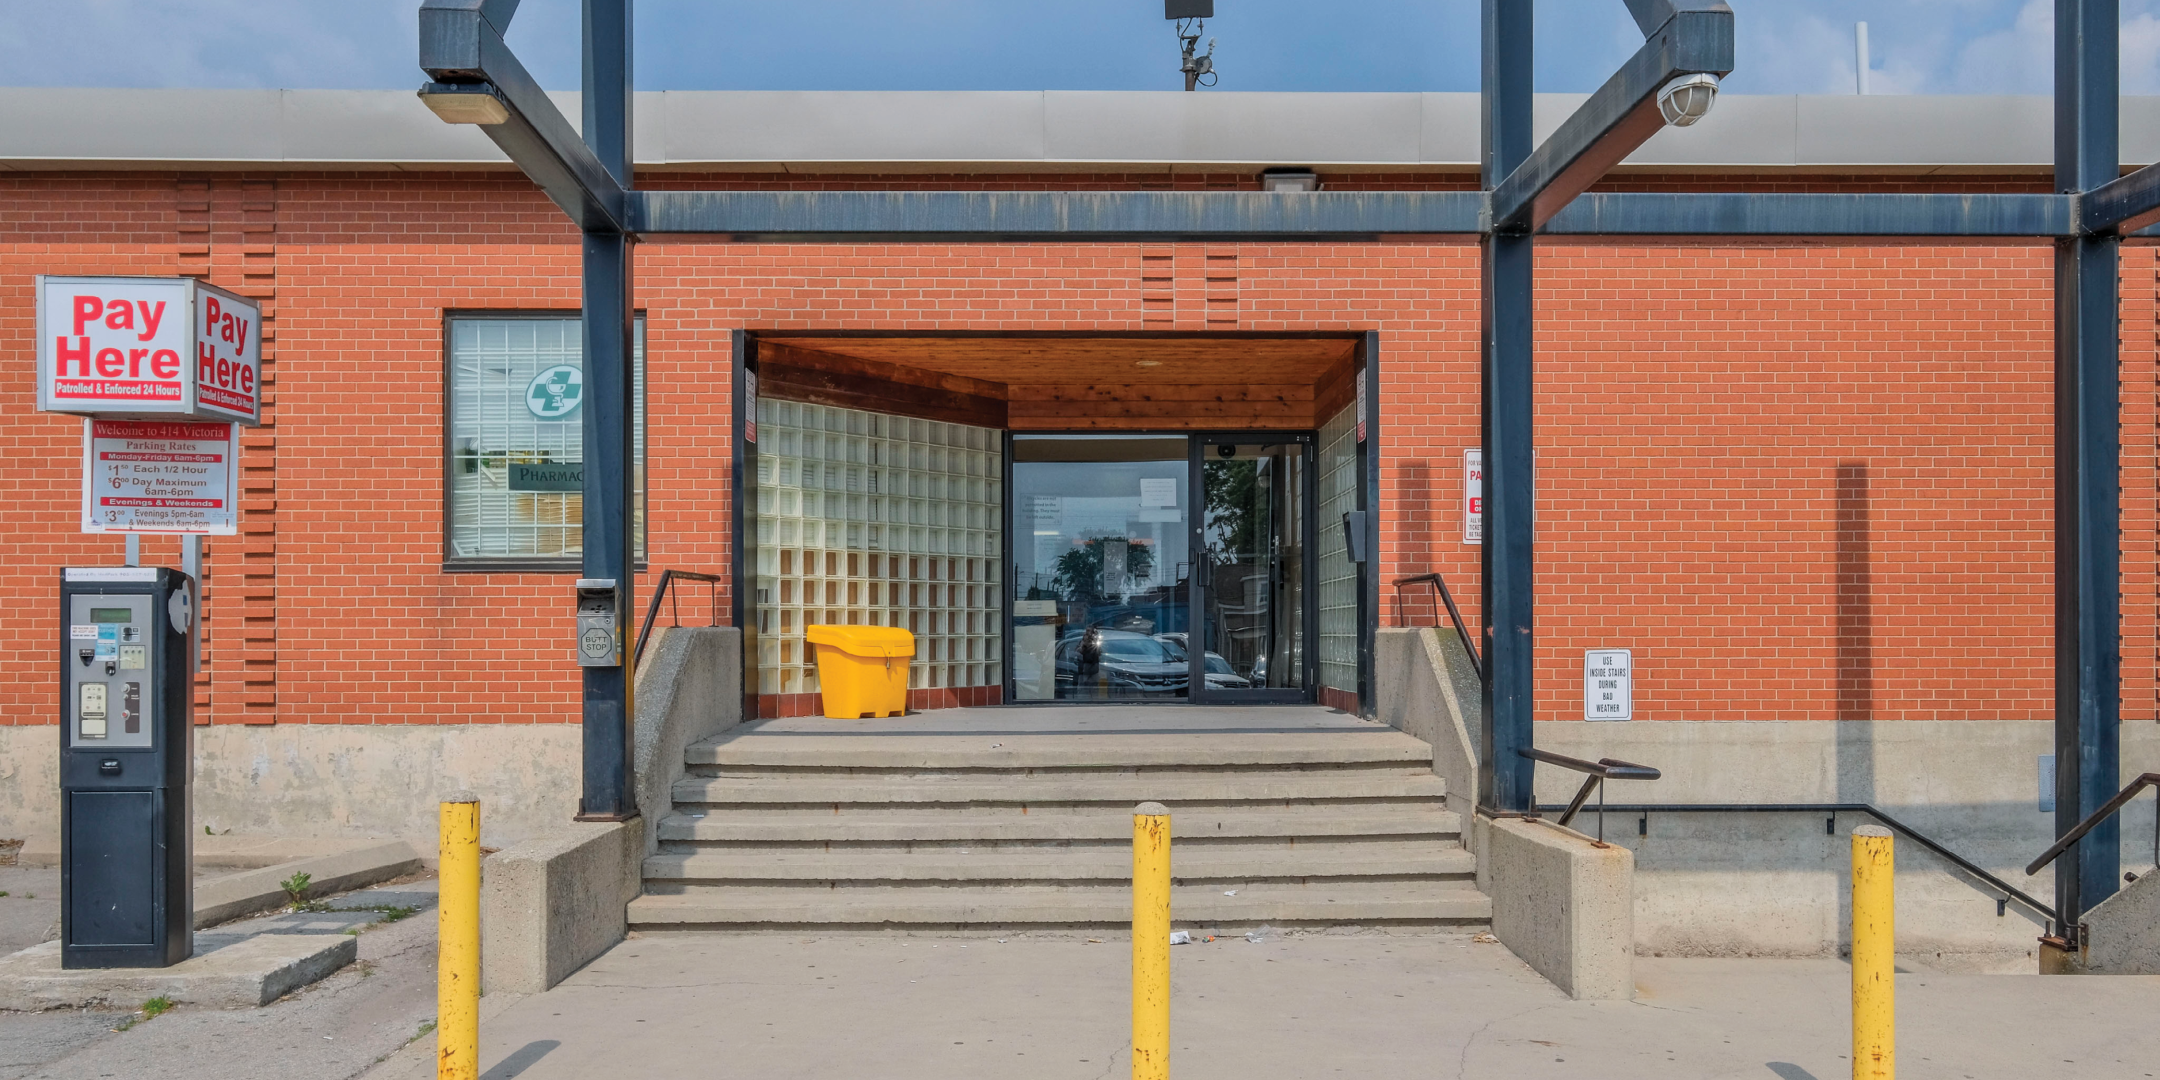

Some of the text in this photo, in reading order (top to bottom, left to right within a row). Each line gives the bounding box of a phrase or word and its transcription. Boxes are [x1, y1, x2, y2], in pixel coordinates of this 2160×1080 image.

[73, 295, 166, 341] Pay
[206, 296, 248, 356] Pay
[56, 336, 180, 379] Here
[199, 341, 253, 393] Here
[56, 382, 180, 396] Patrolled & Enforced 24 Hours
[199, 387, 217, 401] Patrolled
[221, 392, 237, 406] Enforced
[243, 398, 254, 409] Hours
[96, 424, 224, 438] Welcome to 414 Victoria
[126, 441, 196, 452] Parking Rates
[108, 453, 214, 463] Monday-Friday 6am-6pm
[133, 465, 160, 473] Each
[164, 465, 179, 474] 1/2
[182, 466, 208, 474] Hour
[519, 467, 583, 482] PHARMAC
[1470, 470, 1482, 481] PA
[132, 478, 152, 487] Day
[155, 478, 207, 487] Maximum
[144, 488, 194, 497] 6am-6pm
[109, 499, 153, 507] Evenings
[134, 509, 169, 519] Evenings
[171, 510, 205, 519] 5pm-6am
[136, 519, 174, 527] Weekends
[176, 520, 211, 528] 6am-6pm
[586, 643, 607, 651] STOP
[1602, 656, 1613, 665] USE
[1590, 668, 1626, 677] INSIDE STAIRS
[1598, 680, 1617, 689] DURING
[1602, 692, 1613, 700] BAD
[1596, 704, 1620, 712] WEATHER
